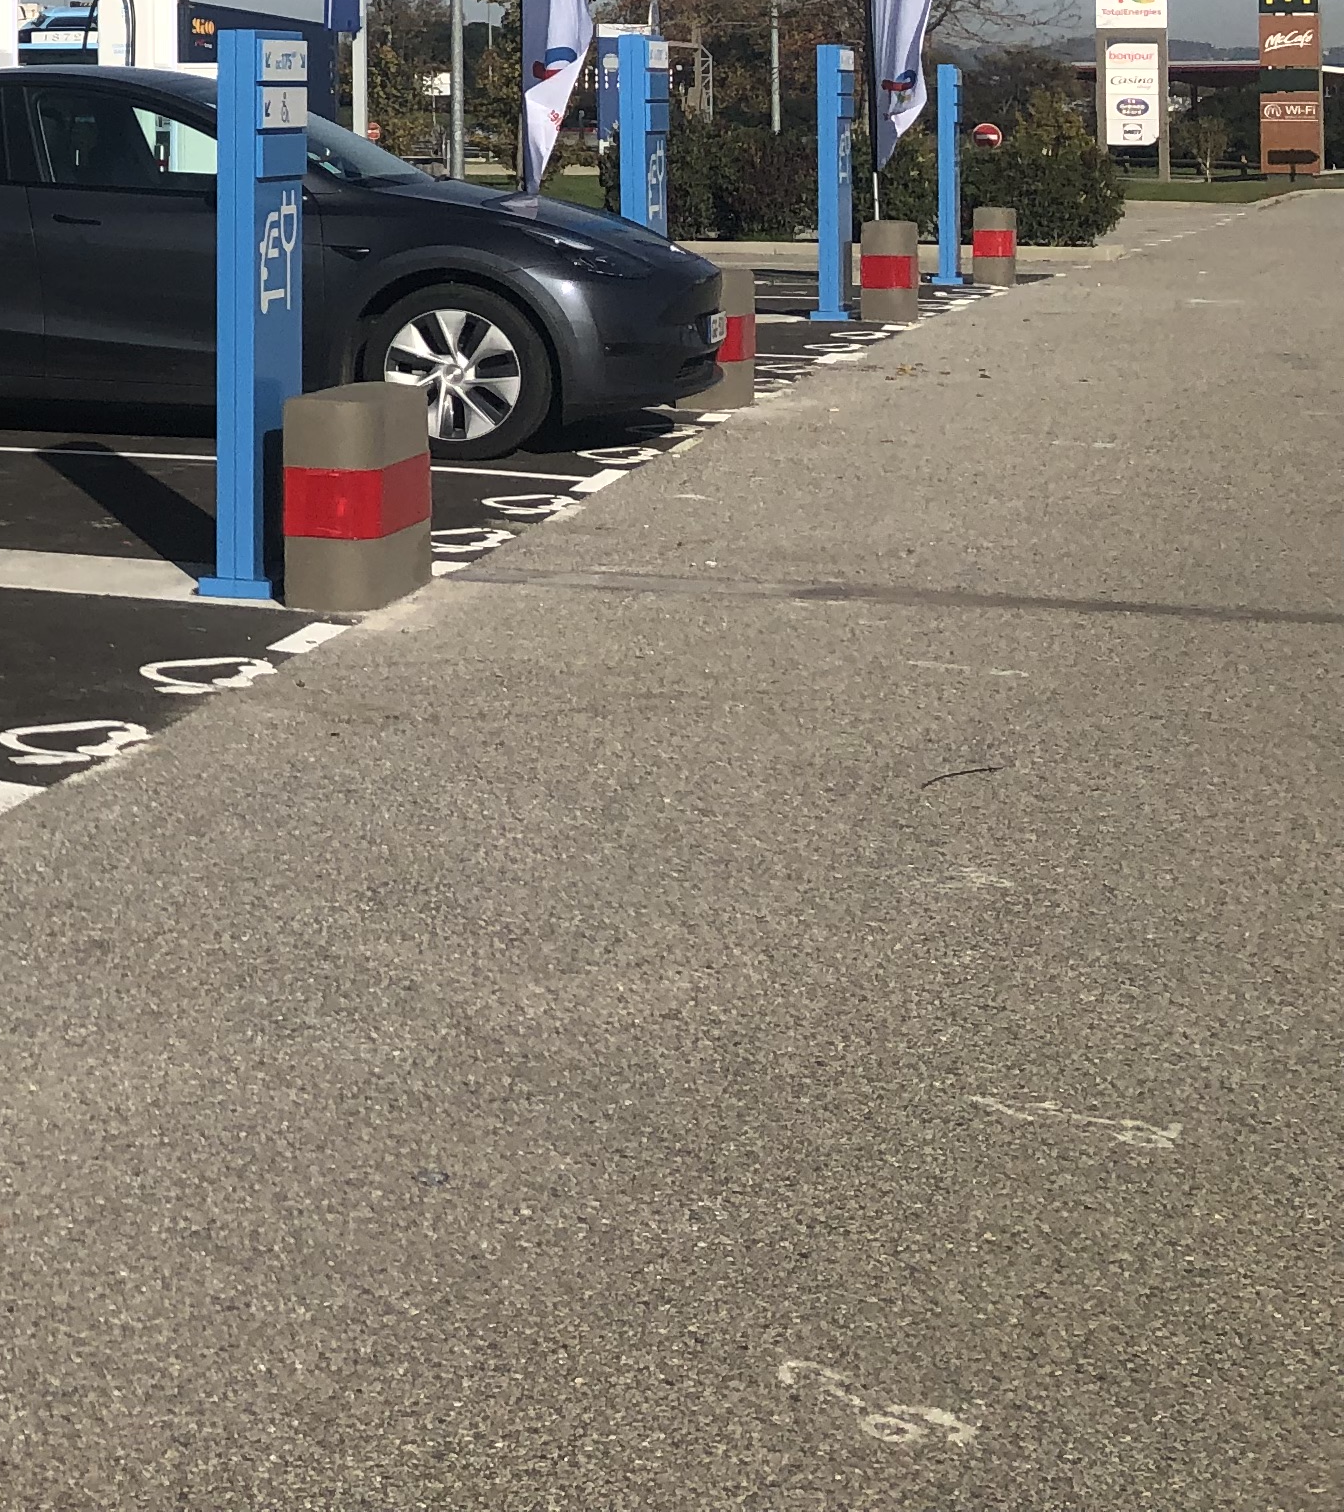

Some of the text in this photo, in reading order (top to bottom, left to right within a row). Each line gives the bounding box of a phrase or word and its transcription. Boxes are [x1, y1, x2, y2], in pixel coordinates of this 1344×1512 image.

[1101, 8, 1162, 17] TotalEnergies
[1108, 51, 1154, 62] bonjour
[1111, 75, 1154, 86] Casino
